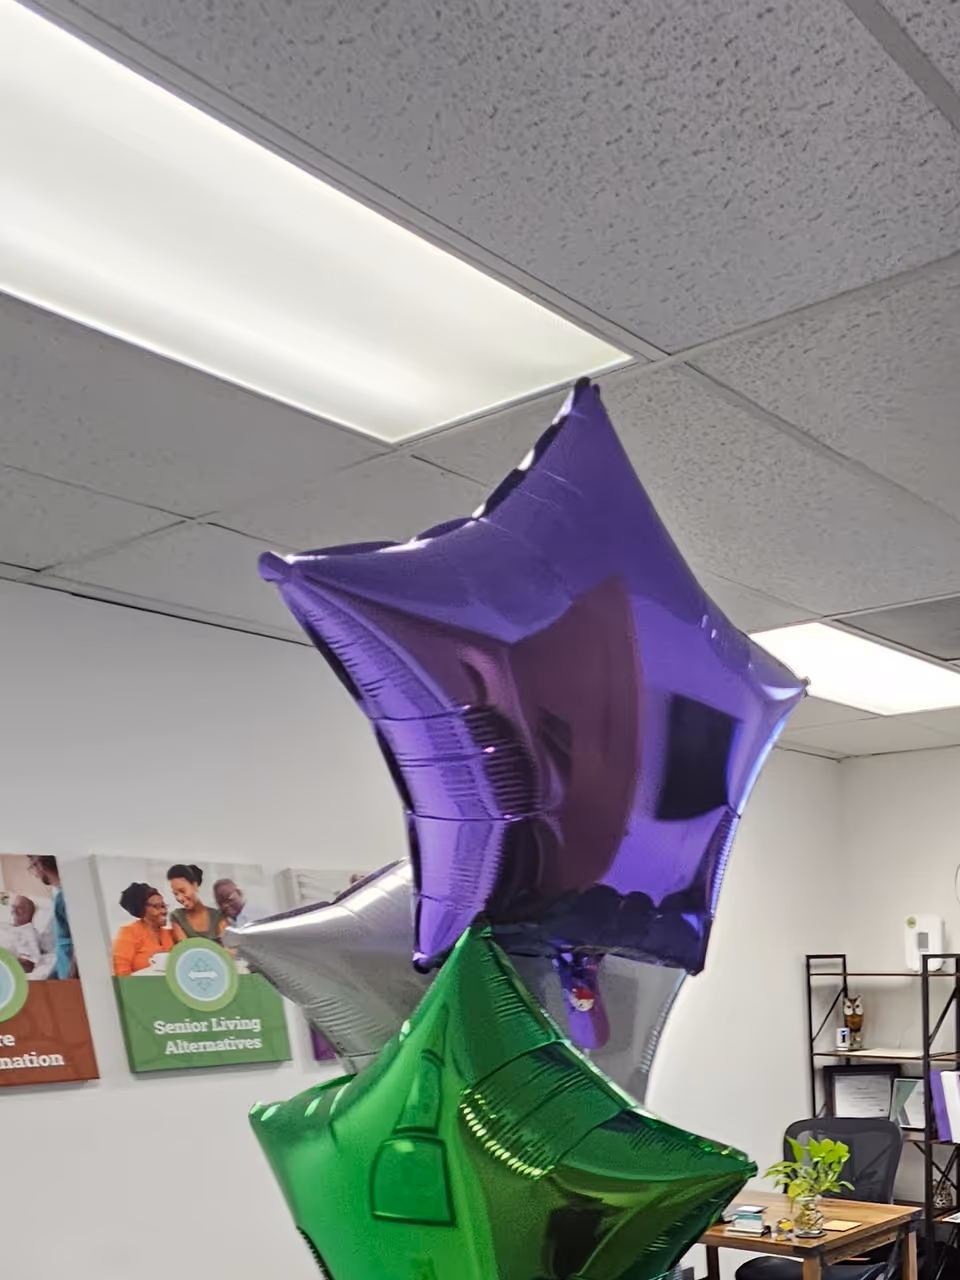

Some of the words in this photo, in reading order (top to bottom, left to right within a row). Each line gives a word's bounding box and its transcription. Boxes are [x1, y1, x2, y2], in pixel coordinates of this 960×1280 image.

[154, 1018, 208, 1035] Senior
[210, 1016, 261, 1032] Living
[165, 1036, 262, 1055] Alternatives
